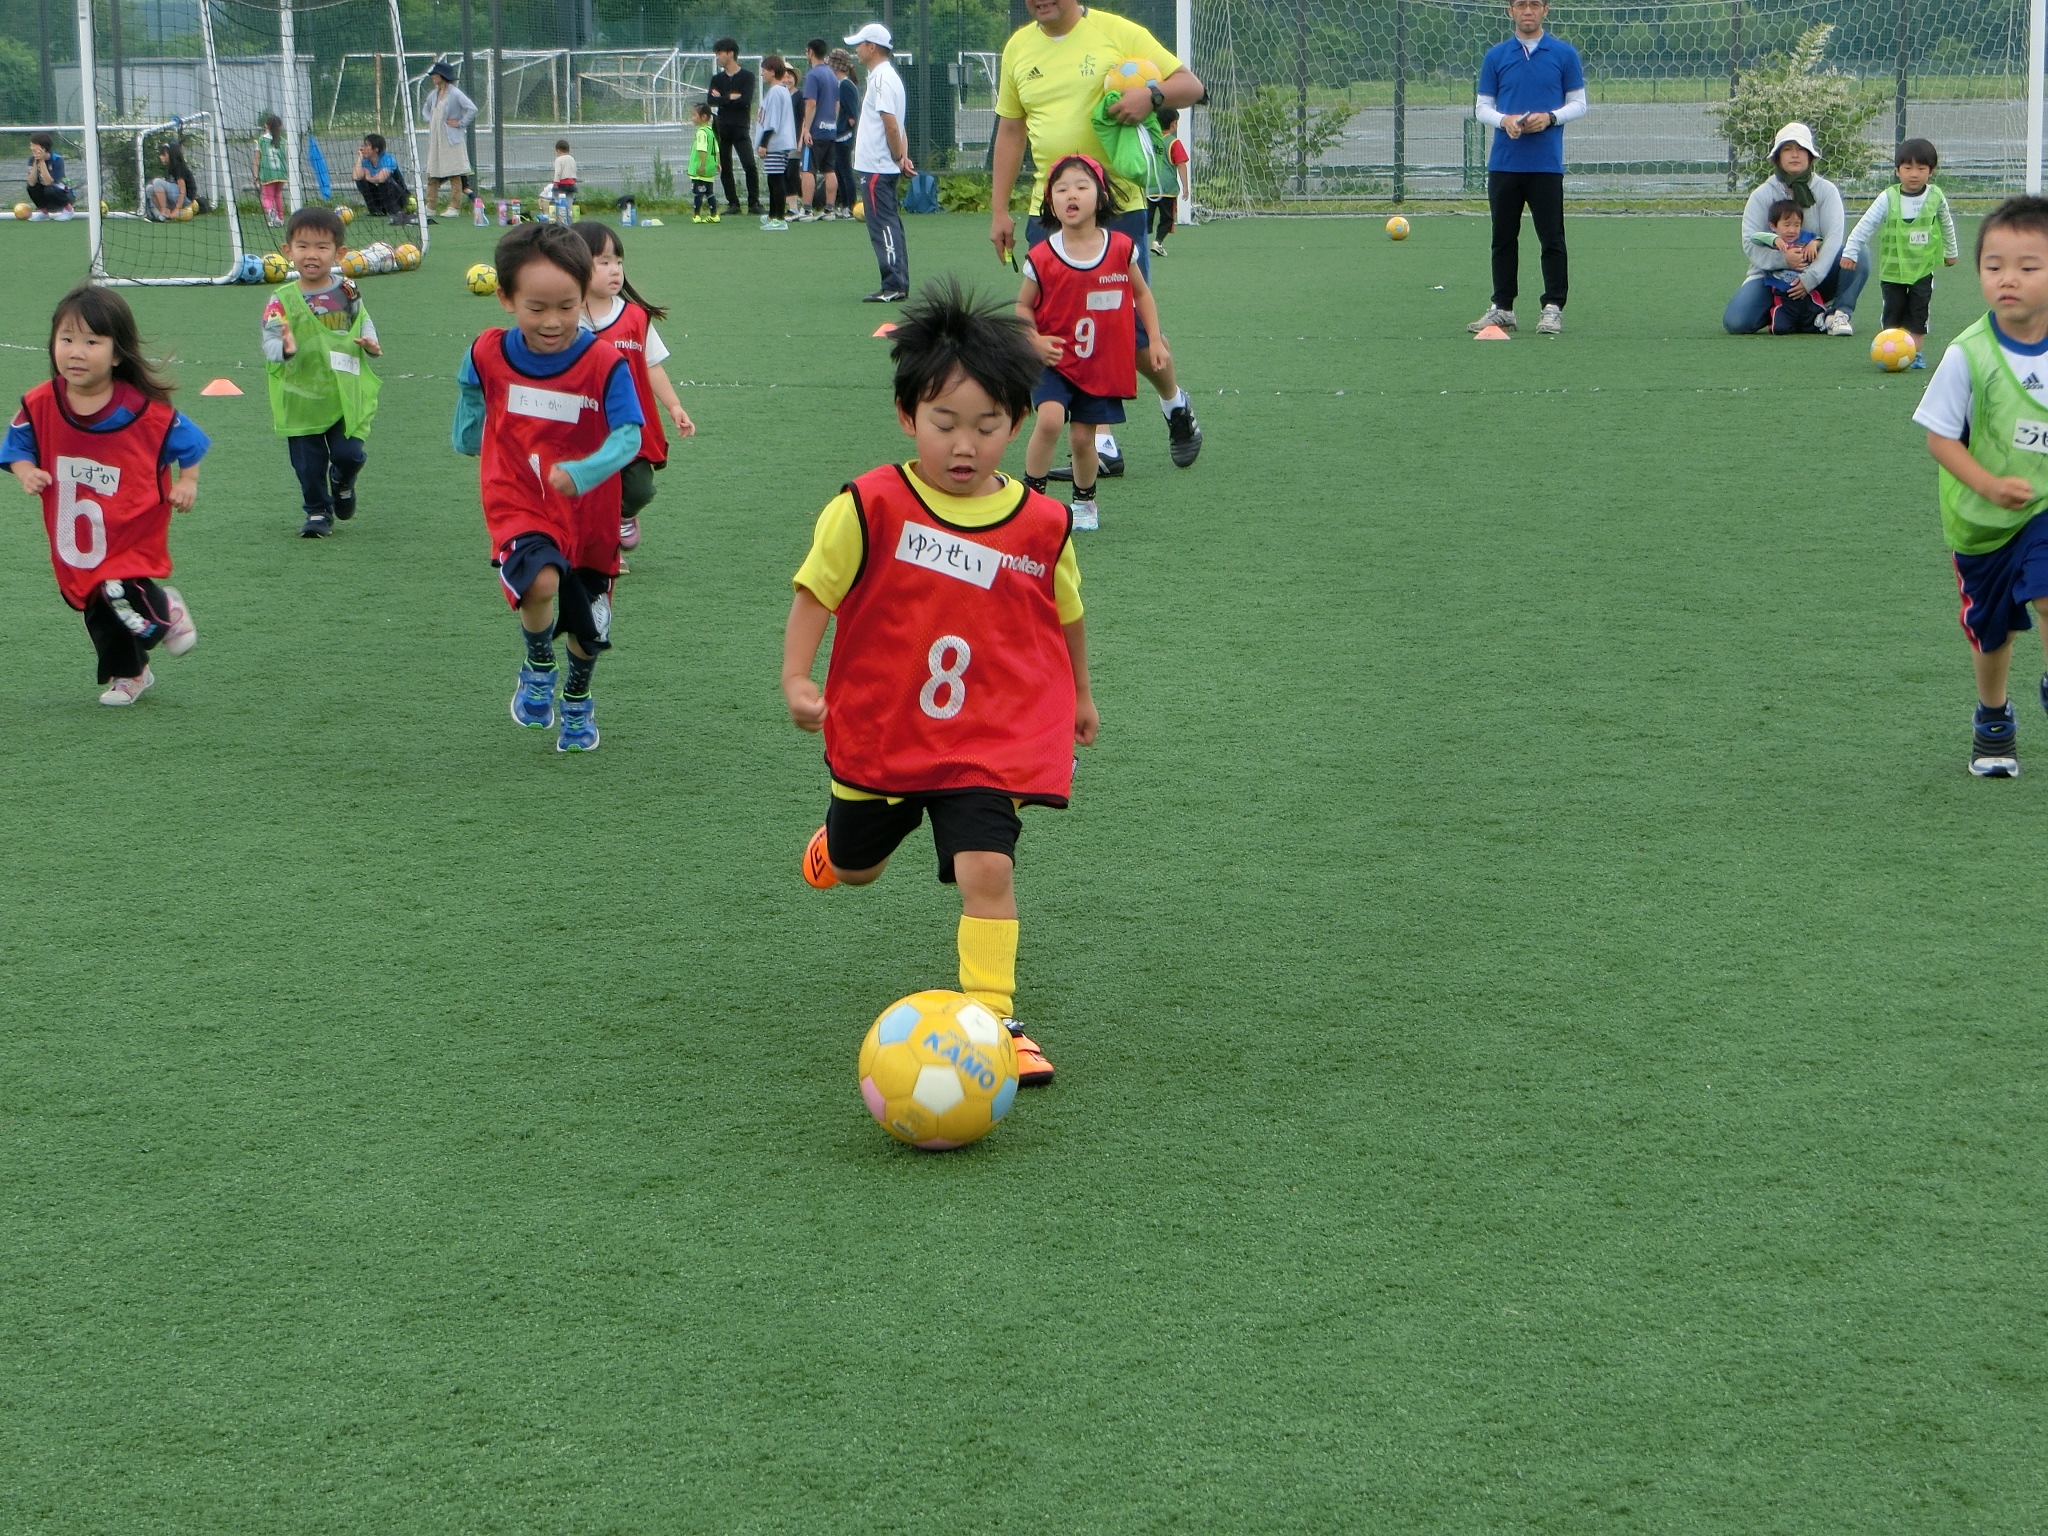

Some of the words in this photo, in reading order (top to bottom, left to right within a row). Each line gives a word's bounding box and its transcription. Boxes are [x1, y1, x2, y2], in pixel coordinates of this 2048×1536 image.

[1080, 69, 1095, 77] YFA
[1098, 272, 1129, 284] molten
[1074, 317, 1095, 359] 9
[71, 464, 116, 484] しずか
[56, 480, 108, 570] 6
[908, 532, 982, 573] ゆうせい
[1000, 552, 1046, 579] molten
[919, 634, 972, 720] 8
[922, 1031, 997, 1091] KAMO
